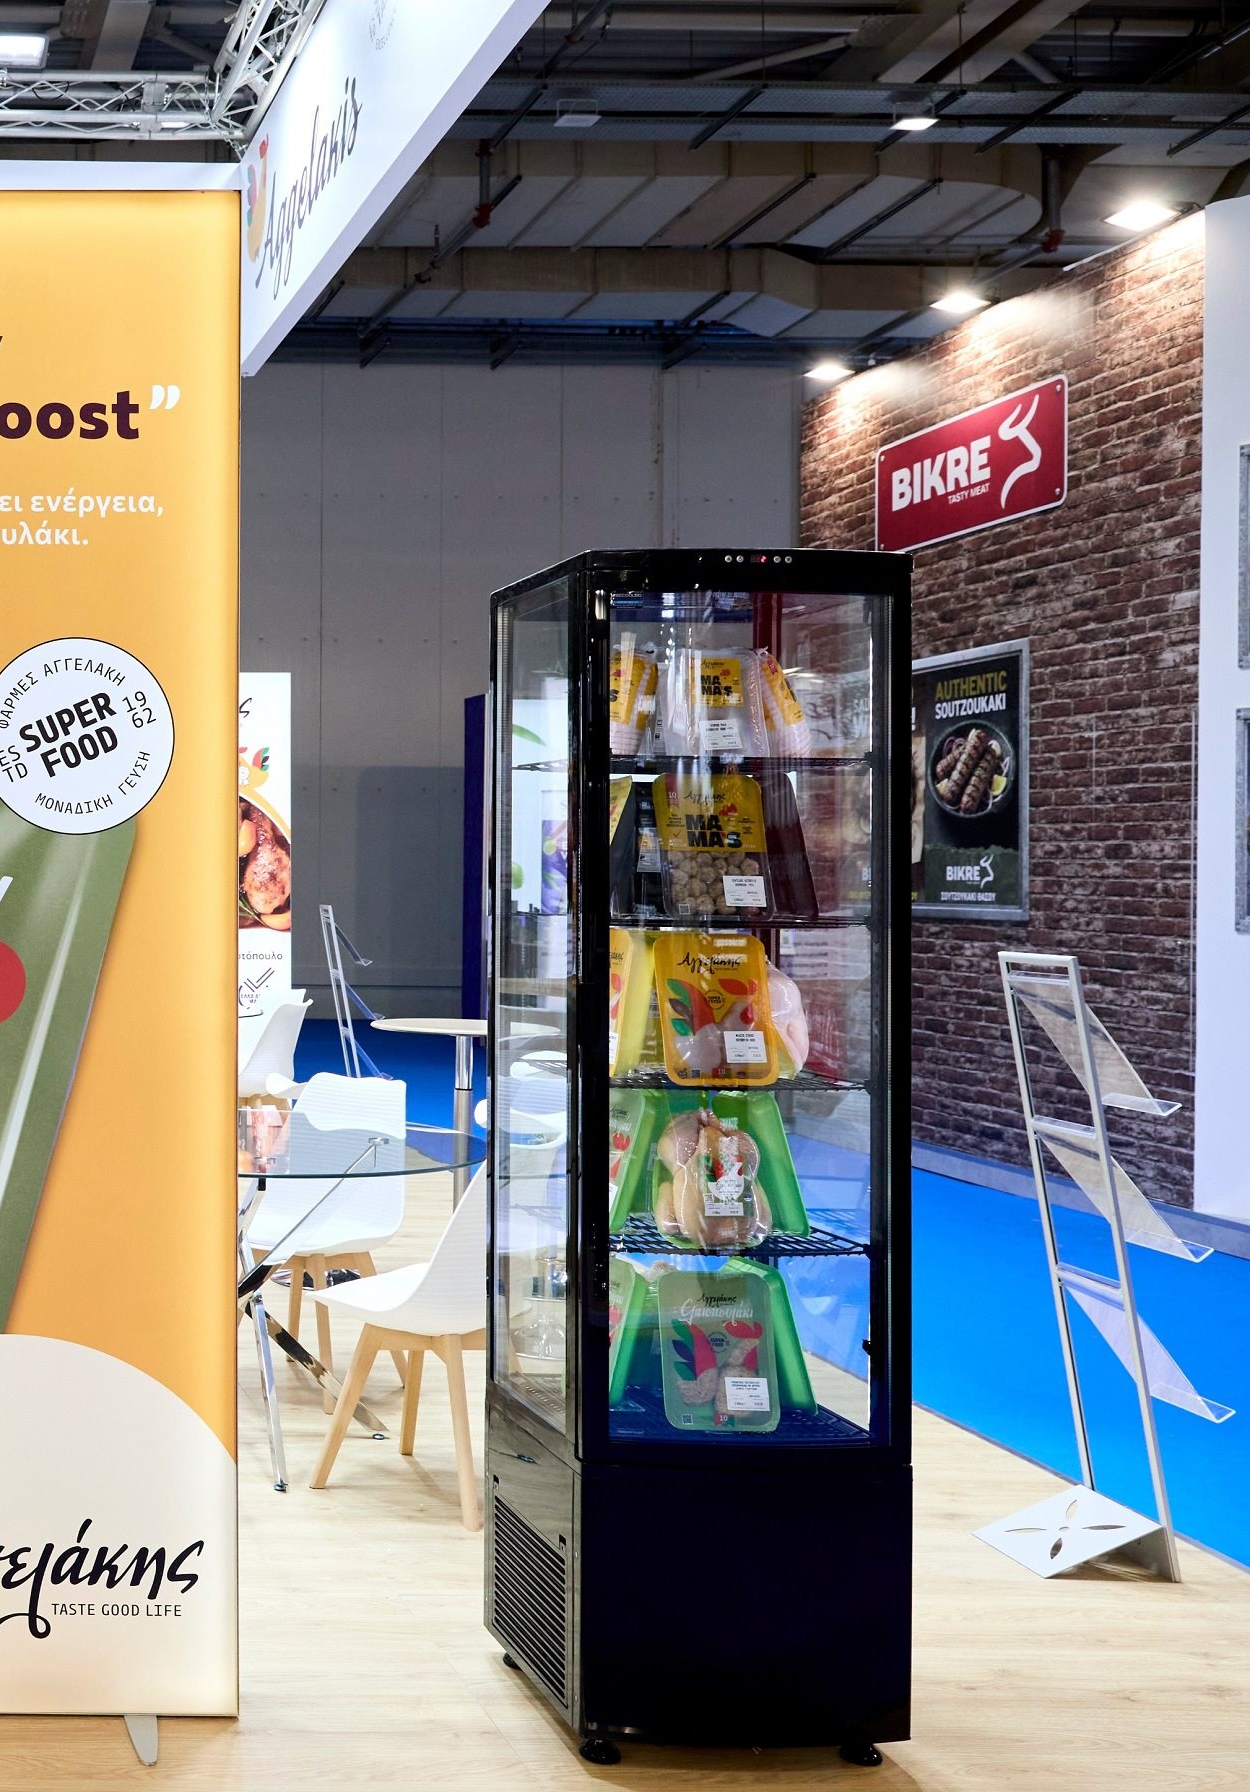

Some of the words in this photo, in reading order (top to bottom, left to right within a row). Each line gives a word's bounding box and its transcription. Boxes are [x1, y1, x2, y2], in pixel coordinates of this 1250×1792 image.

[255, 76, 363, 300] Aggelakis
[892, 435, 991, 512] BIKRE
[30, 487, 164, 518] ενέργεια,
[947, 490, 969, 504] TASTY
[969, 482, 990, 498] MEAT
[43, 658, 125, 686] ΑΓΓΕΛΑΚΗ
[935, 670, 1007, 700] AUTHENTIC
[122, 691, 147, 713] 19
[935, 693, 1007, 719] SOUTZOUKAKI
[19, 692, 117, 753] SUPER
[131, 707, 157, 729] 62
[40, 726, 118, 778] FOOD
[2, 762, 28, 783] TD
[35, 792, 113, 814] ΜΟΝΑΔΙΚΗ
[118, 751, 150, 795] ΓΕΥΣΗ
[685, 814, 724, 831] MA
[946, 865, 981, 881] BIKRE
[51, 1603, 96, 1616] TASTE
[101, 1604, 140, 1617] GOOD
[146, 1604, 182, 1617] LIFE
